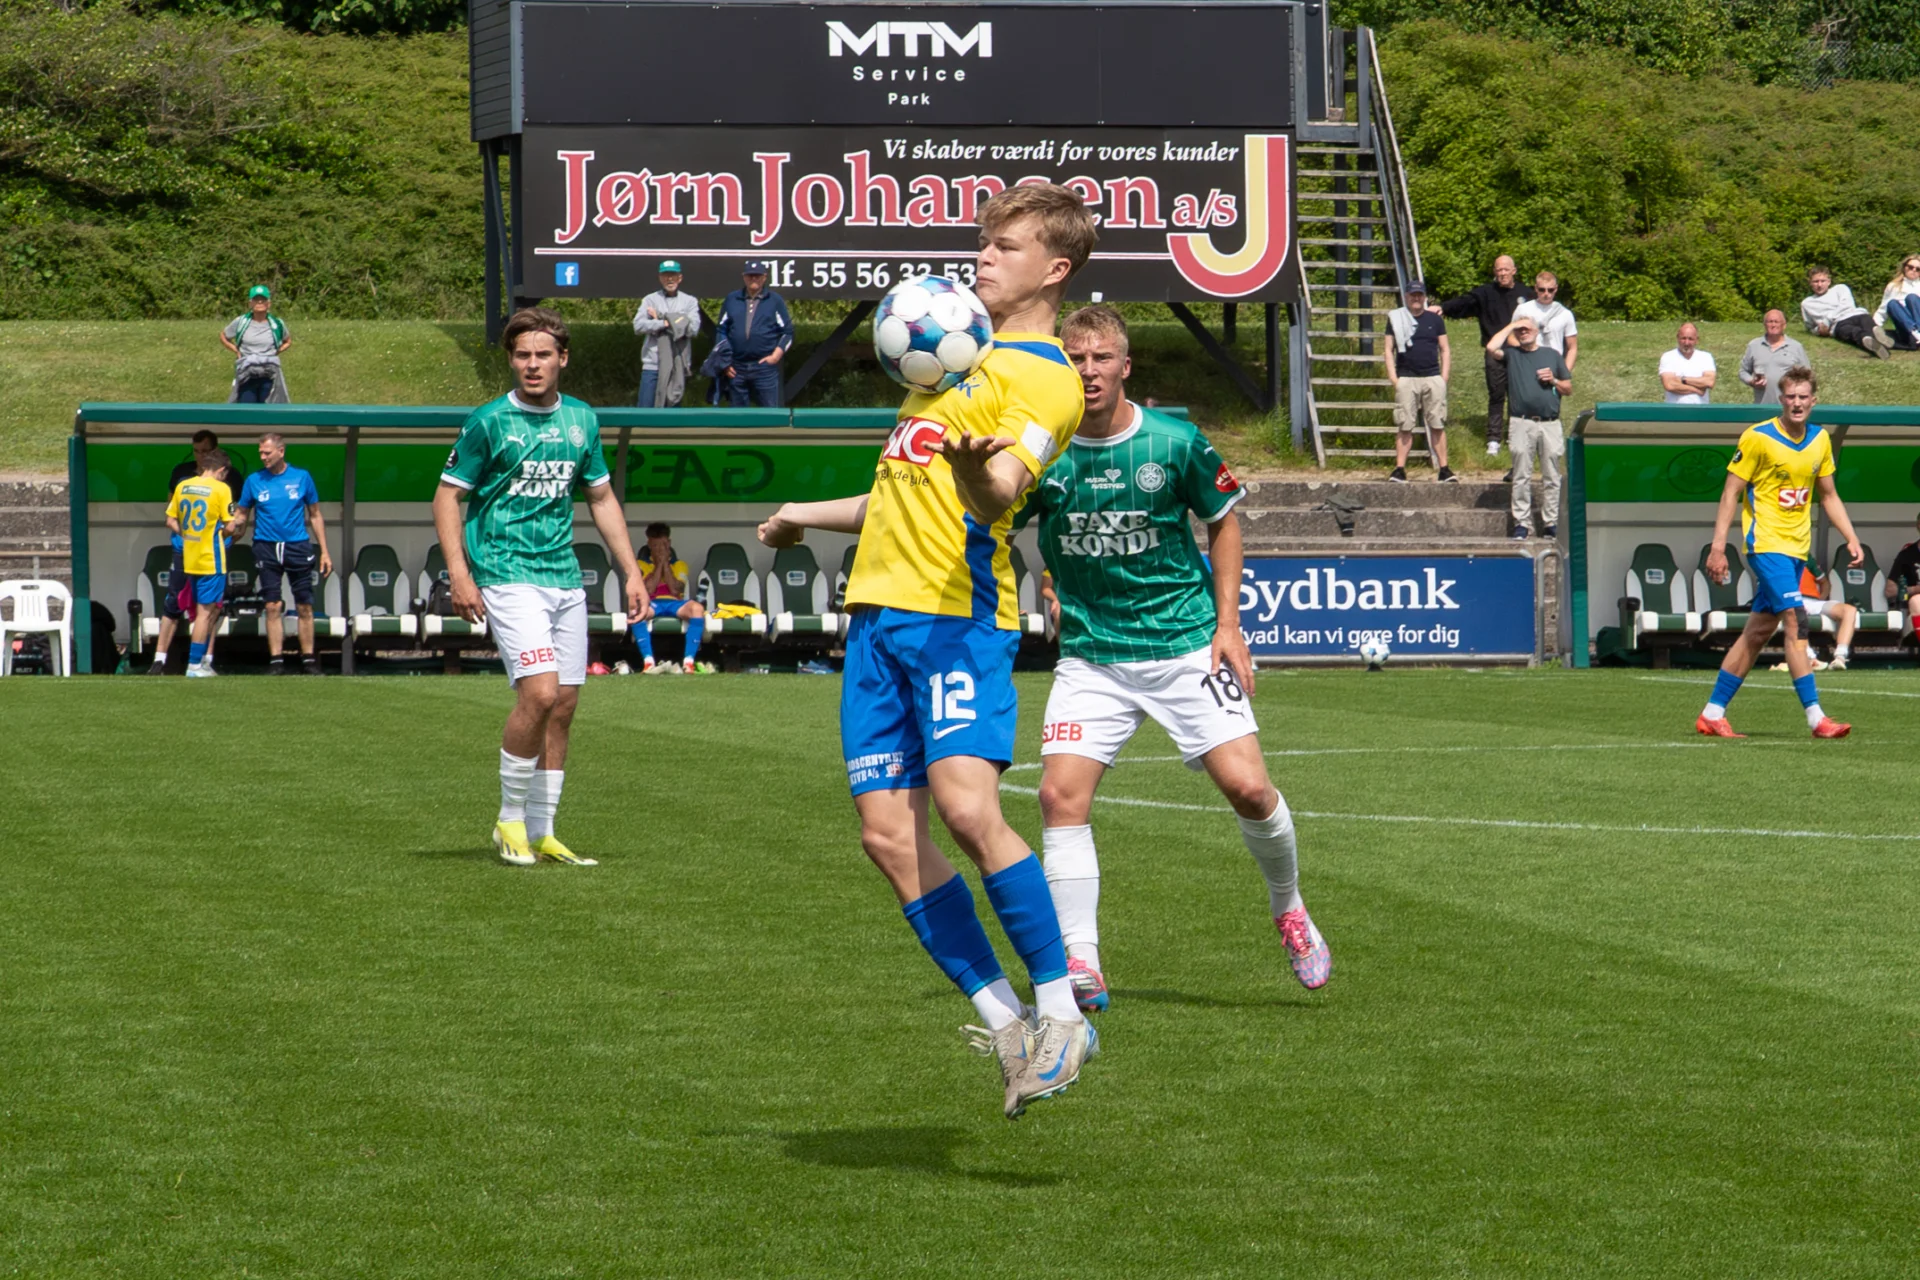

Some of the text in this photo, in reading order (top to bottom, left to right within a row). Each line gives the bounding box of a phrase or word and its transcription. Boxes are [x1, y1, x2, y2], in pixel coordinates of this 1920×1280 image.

[824, 21, 993, 57] MTM
[852, 65, 966, 81] Service
[888, 92, 930, 105] Park
[883, 139, 1240, 166] Vi skaber værdi for vores kunder
[554, 150, 1238, 246] Jørn Johanen a/s
[745, 260, 803, 288] lf.
[812, 261, 847, 288] 55
[855, 262, 890, 288] 56
[943, 263, 977, 289] 53
[521, 460, 576, 479] FAXE
[507, 478, 571, 499] KON
[180, 498, 208, 533] 23
[1066, 510, 1149, 535] FAXE
[1058, 527, 1161, 558] KONDI
[1238, 568, 1460, 622] Sydbank
[1240, 624, 1460, 648] vad kan vi gøre for dig
[520, 647, 555, 667] SJEB
[928, 671, 977, 722] 12
[1200, 668, 1242, 708] 18
[1041, 722, 1083, 744] SJEB
